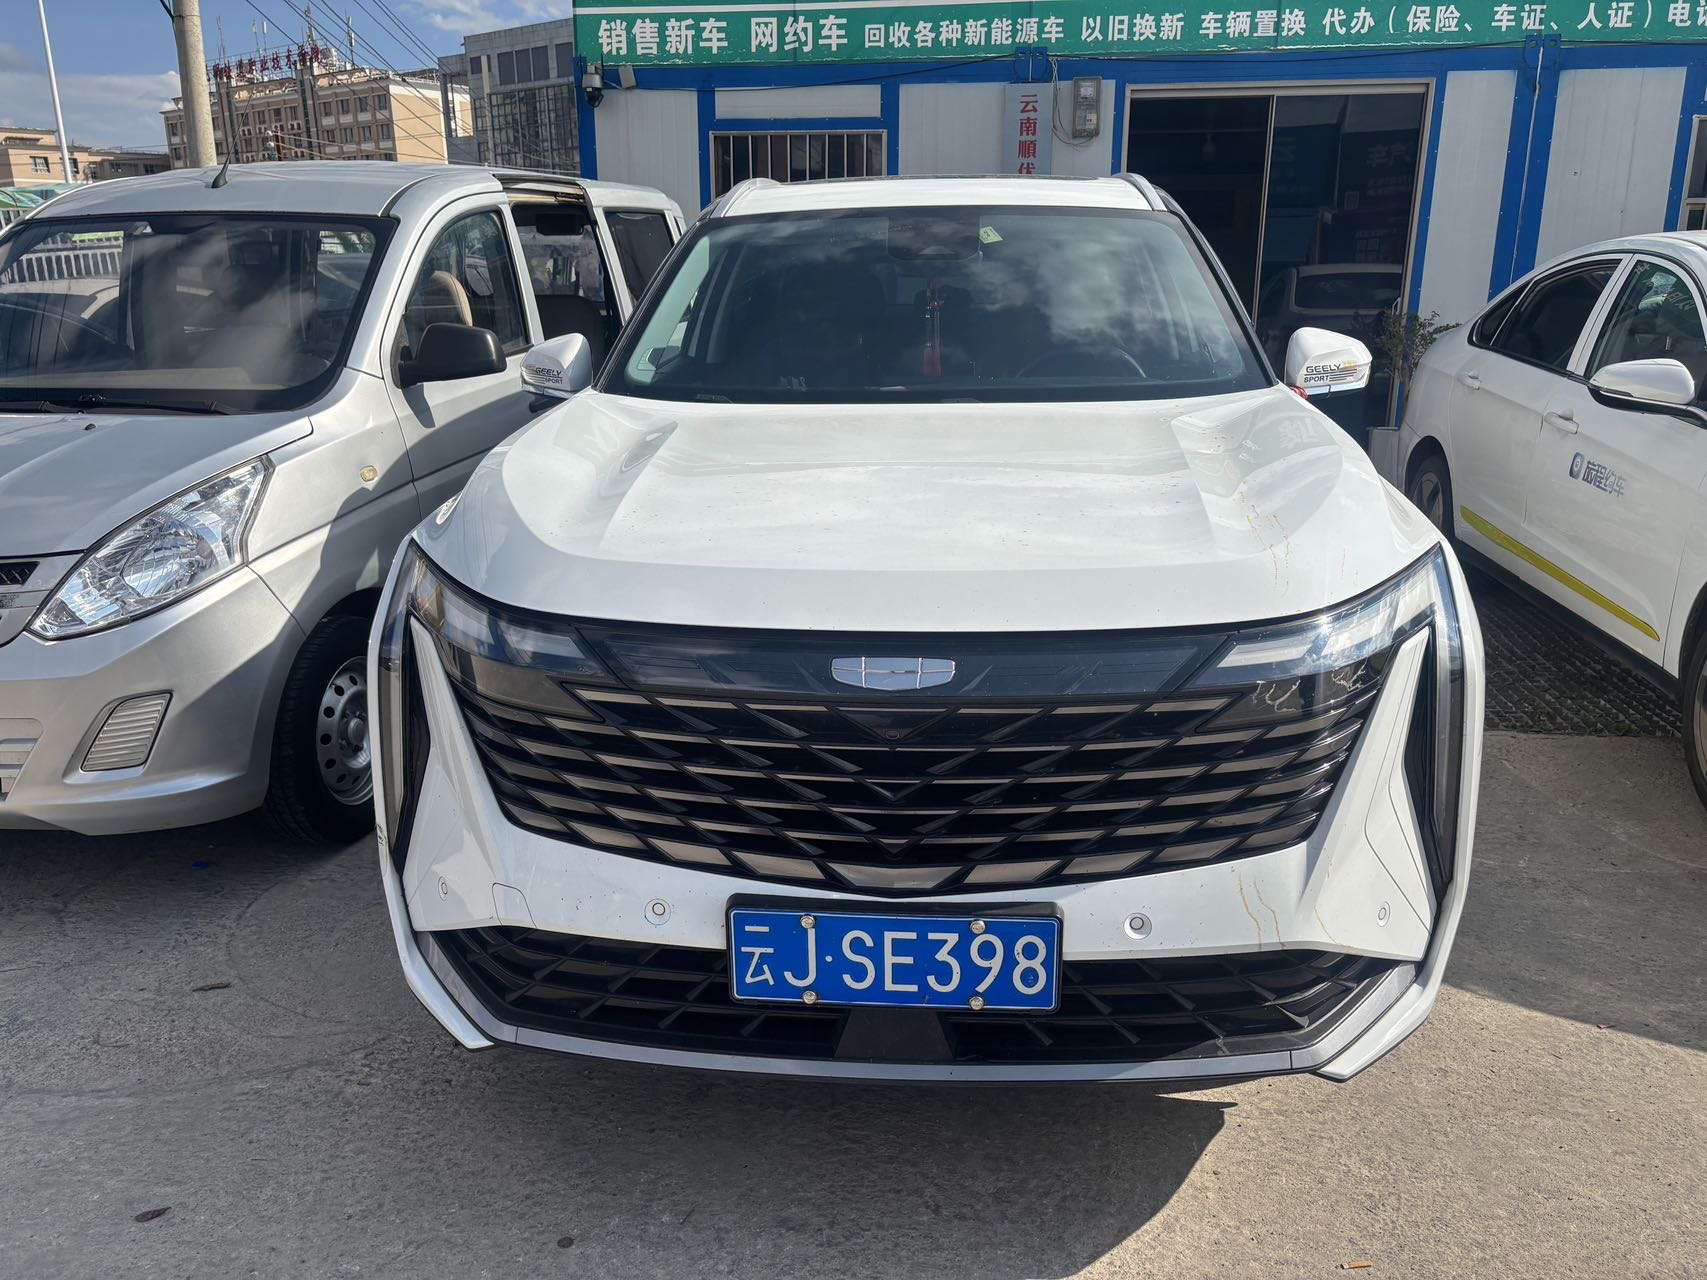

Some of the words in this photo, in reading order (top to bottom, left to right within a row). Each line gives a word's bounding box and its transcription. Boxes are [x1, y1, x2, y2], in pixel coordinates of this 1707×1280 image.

[598, 17, 729, 56] 销售新车
[750, 15, 848, 54] 网约车
[864, 15, 1065, 49] 回收各种新能源车
[1081, 12, 1185, 43] 以旧换新
[1199, 9, 1307, 39] 车辆置换
[535, 367, 562, 376] GEELY
[1305, 363, 1342, 374] GEELY
[545, 377, 563, 385] SPORT
[1303, 375, 1330, 383] SPORT
[739, 925, 1048, 996] 云J·SE398
